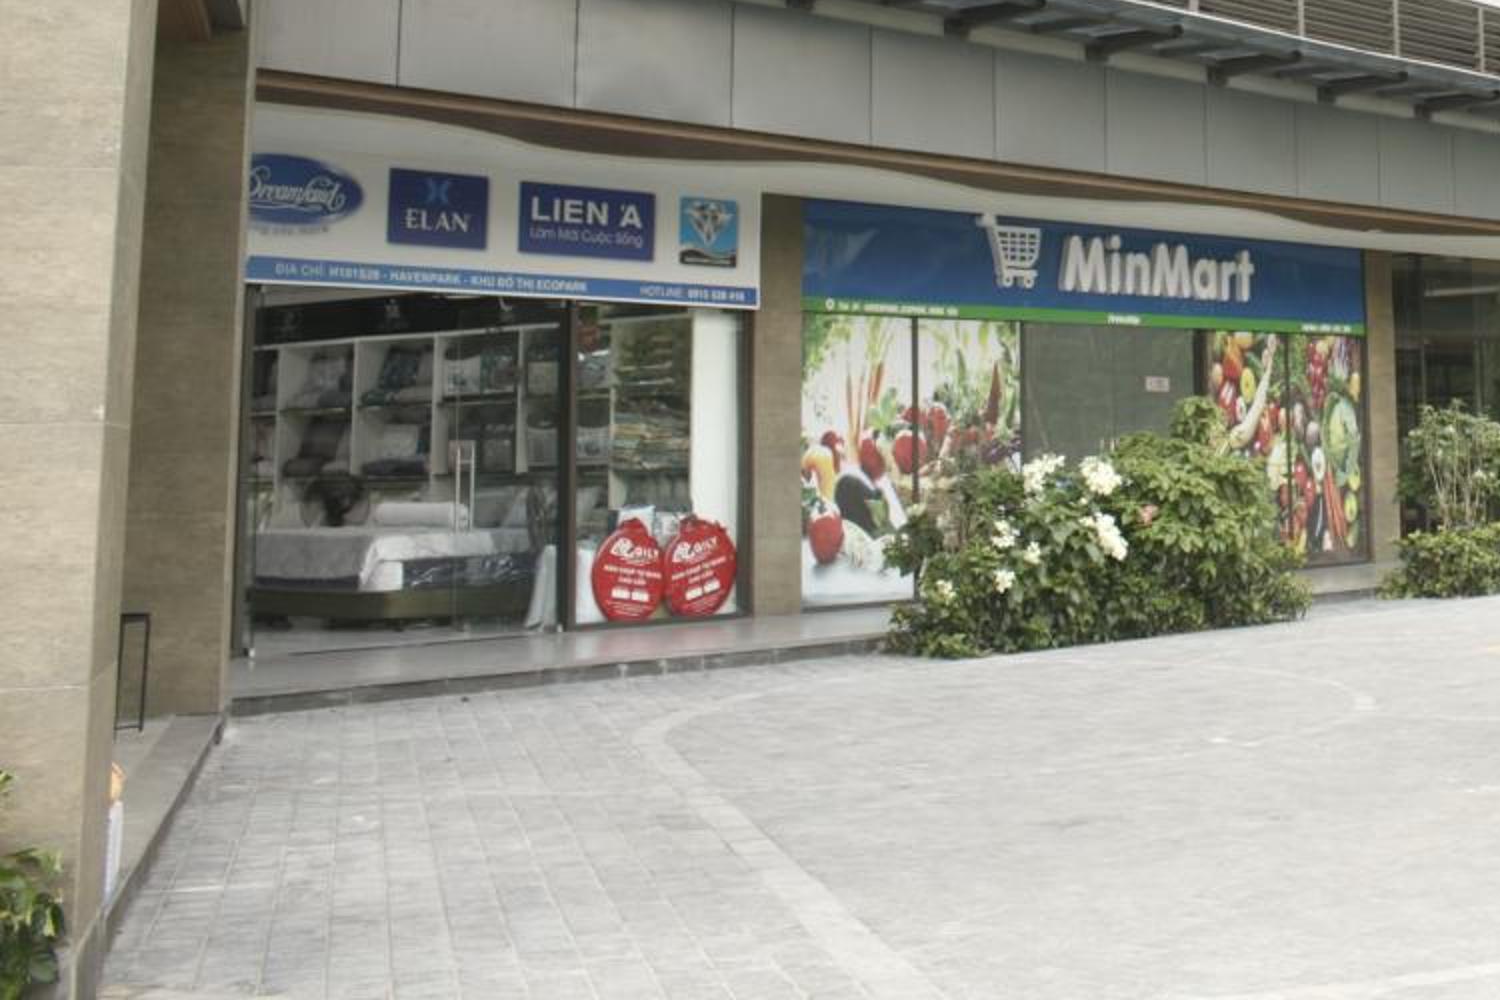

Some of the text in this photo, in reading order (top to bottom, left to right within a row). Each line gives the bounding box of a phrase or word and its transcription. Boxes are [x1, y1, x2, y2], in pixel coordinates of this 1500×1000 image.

[404, 206, 471, 233] ELAN
[530, 196, 609, 227] LIEN
[1059, 233, 1256, 303] MinMart
